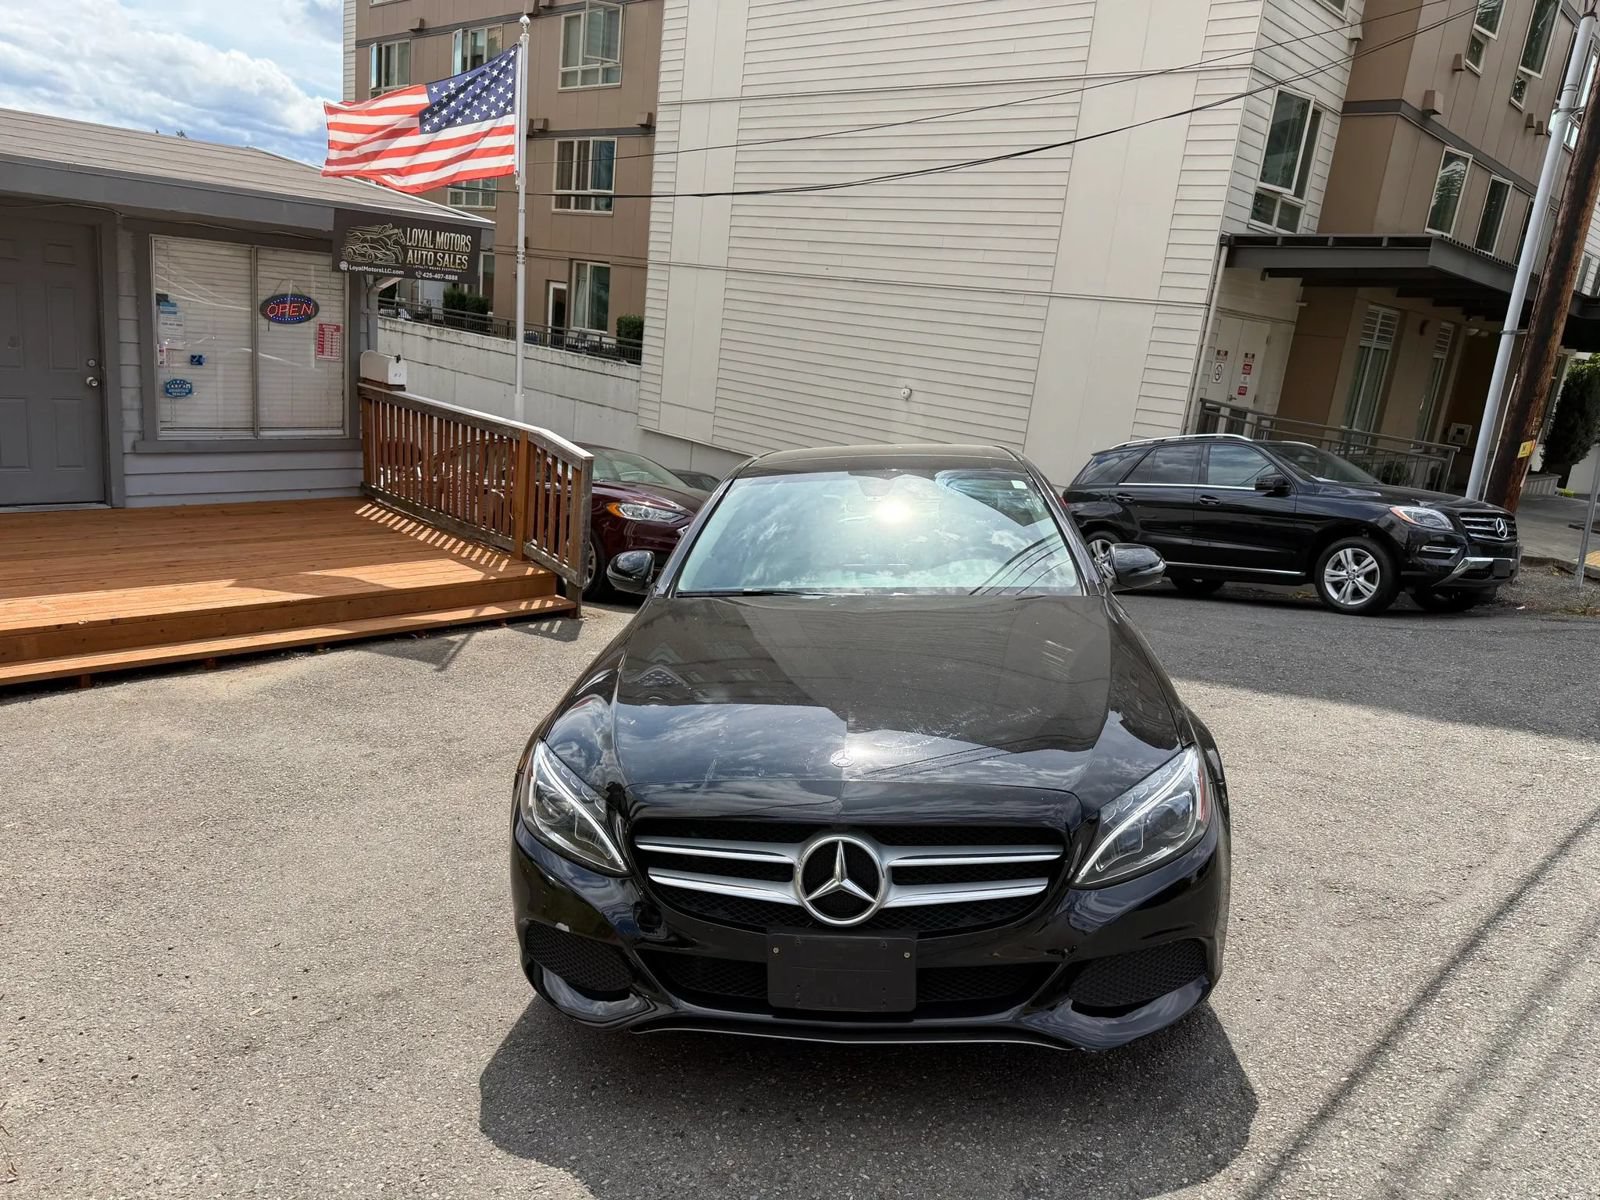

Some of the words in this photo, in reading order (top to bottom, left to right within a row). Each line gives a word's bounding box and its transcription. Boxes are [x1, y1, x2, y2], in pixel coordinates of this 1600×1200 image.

[406, 227, 434, 248] LOYAL
[435, 231, 472, 252] MOTORS
[406, 249, 435, 266] AUTO
[436, 252, 469, 270] SALES
[349, 264, 405, 275] LoyalMotorsLLC.com
[267, 303, 313, 317] OPEN
